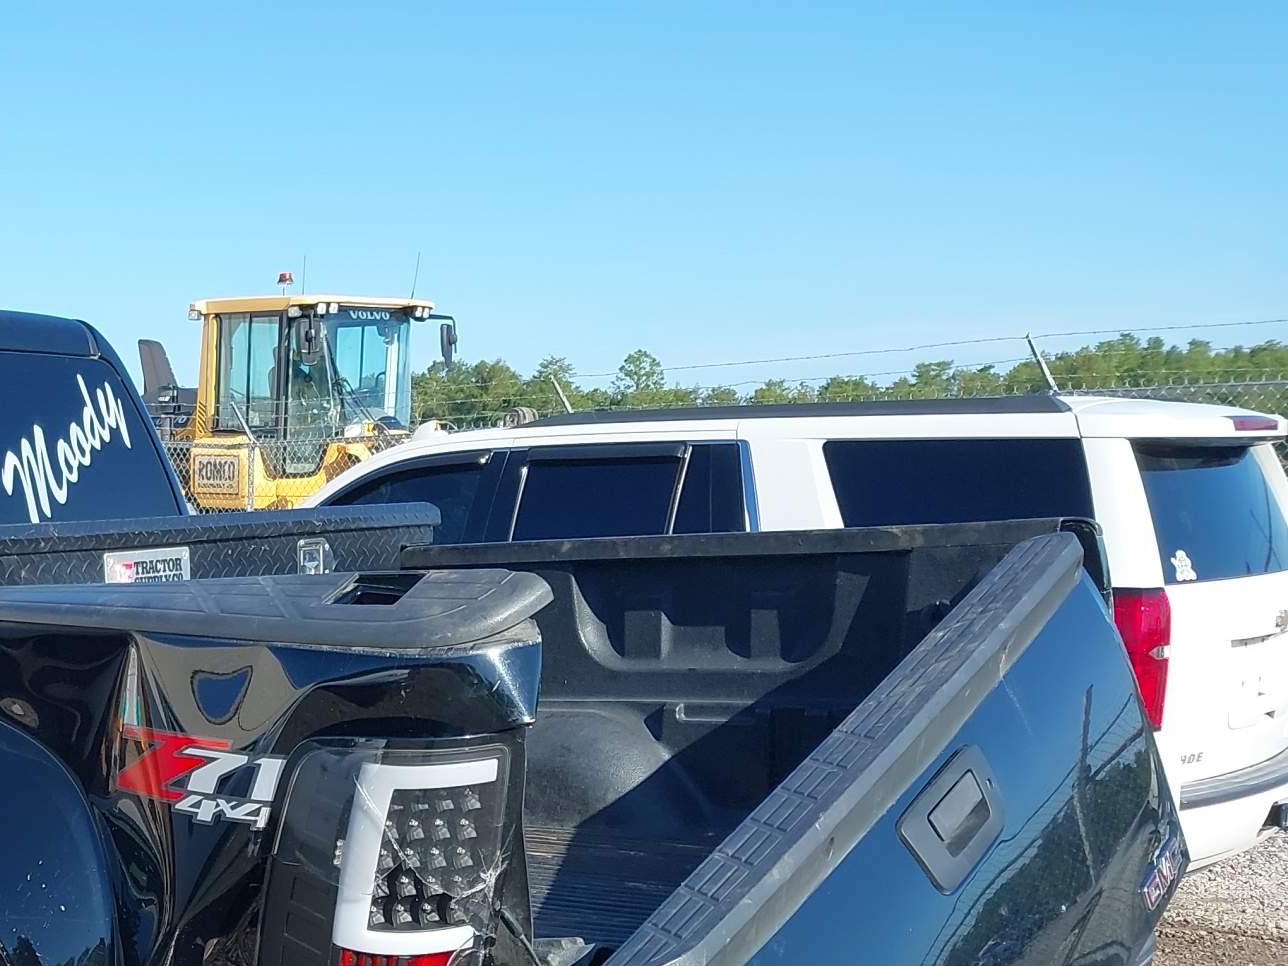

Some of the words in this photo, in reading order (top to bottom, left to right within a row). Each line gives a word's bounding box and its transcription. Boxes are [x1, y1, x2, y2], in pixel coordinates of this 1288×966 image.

[347, 309, 391, 321] VOLVO
[1, 373, 132, 524] Moody
[198, 460, 236, 481] ROMCO
[133, 557, 183, 576] TRACTOR
[117, 725, 288, 802] Z71
